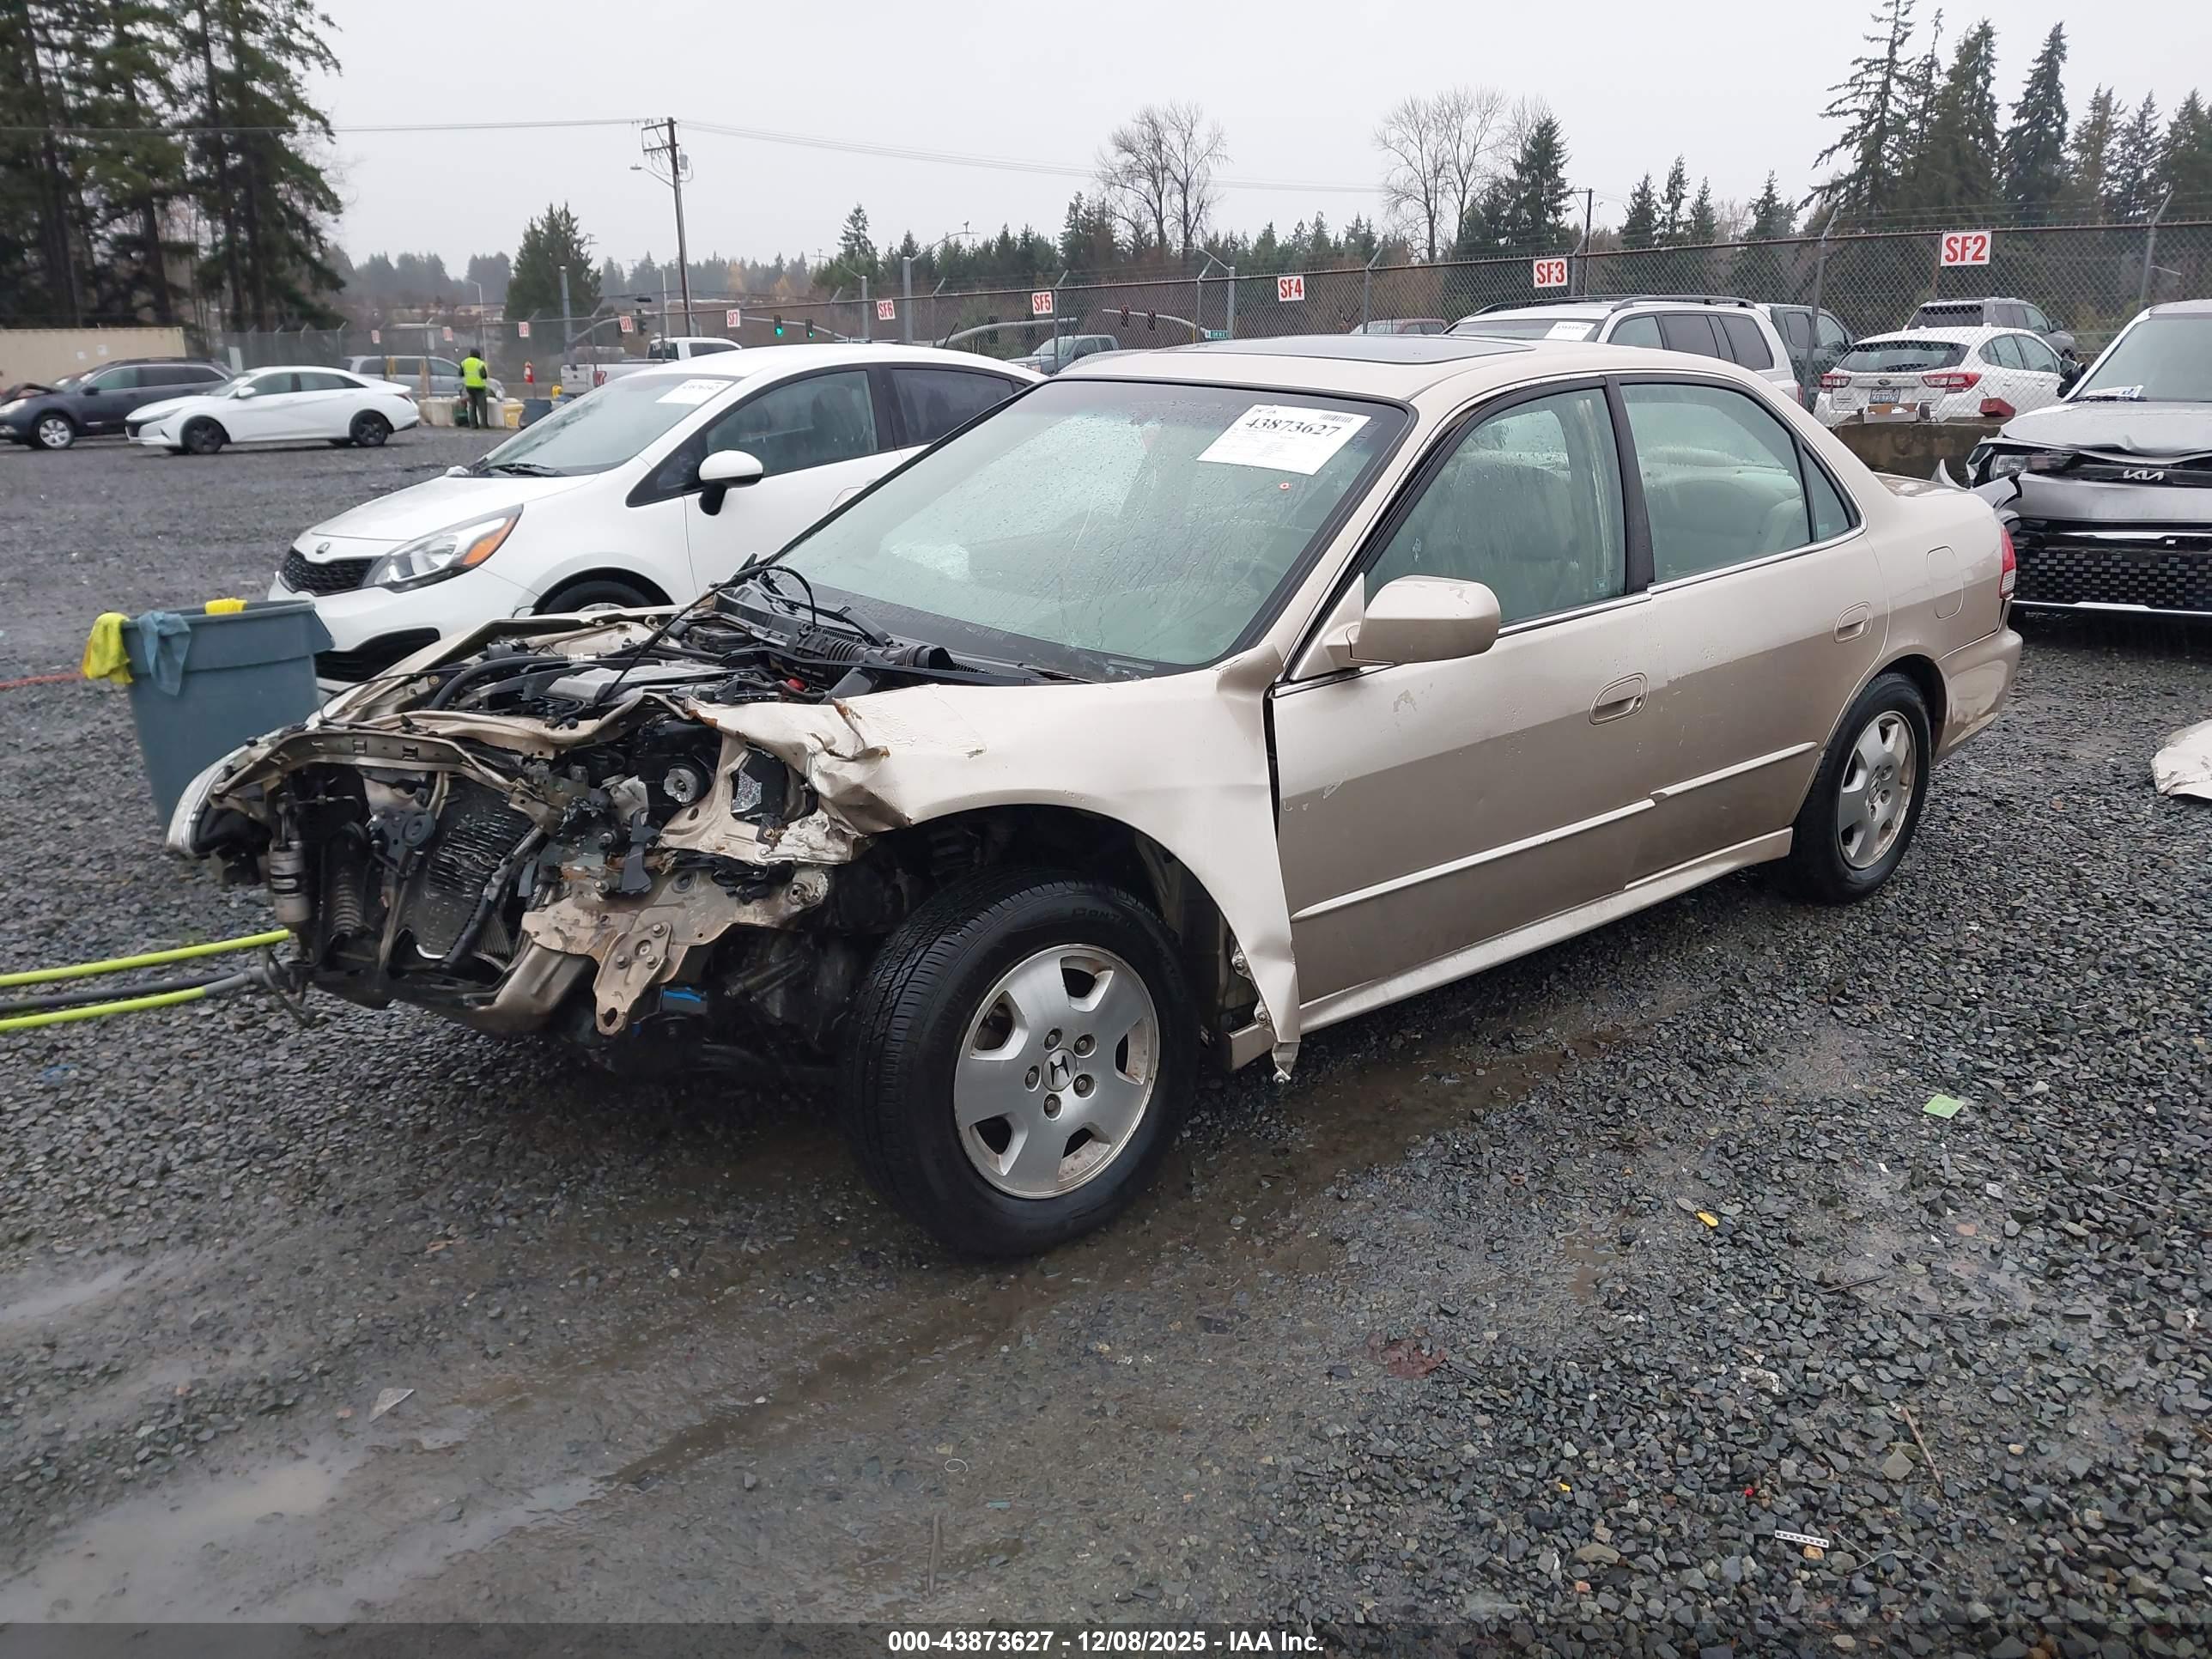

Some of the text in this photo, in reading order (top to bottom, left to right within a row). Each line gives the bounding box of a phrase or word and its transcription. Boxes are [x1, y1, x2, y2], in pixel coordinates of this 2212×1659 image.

[1944, 234, 1987, 263] SF2
[1536, 261, 1565, 284] SF3
[1279, 278, 1303, 299] SF4
[878, 301, 894, 318] SF6
[1033, 294, 1051, 312] SF5
[728, 312, 738, 325] SF7
[1245, 417, 1342, 436] 43873627
